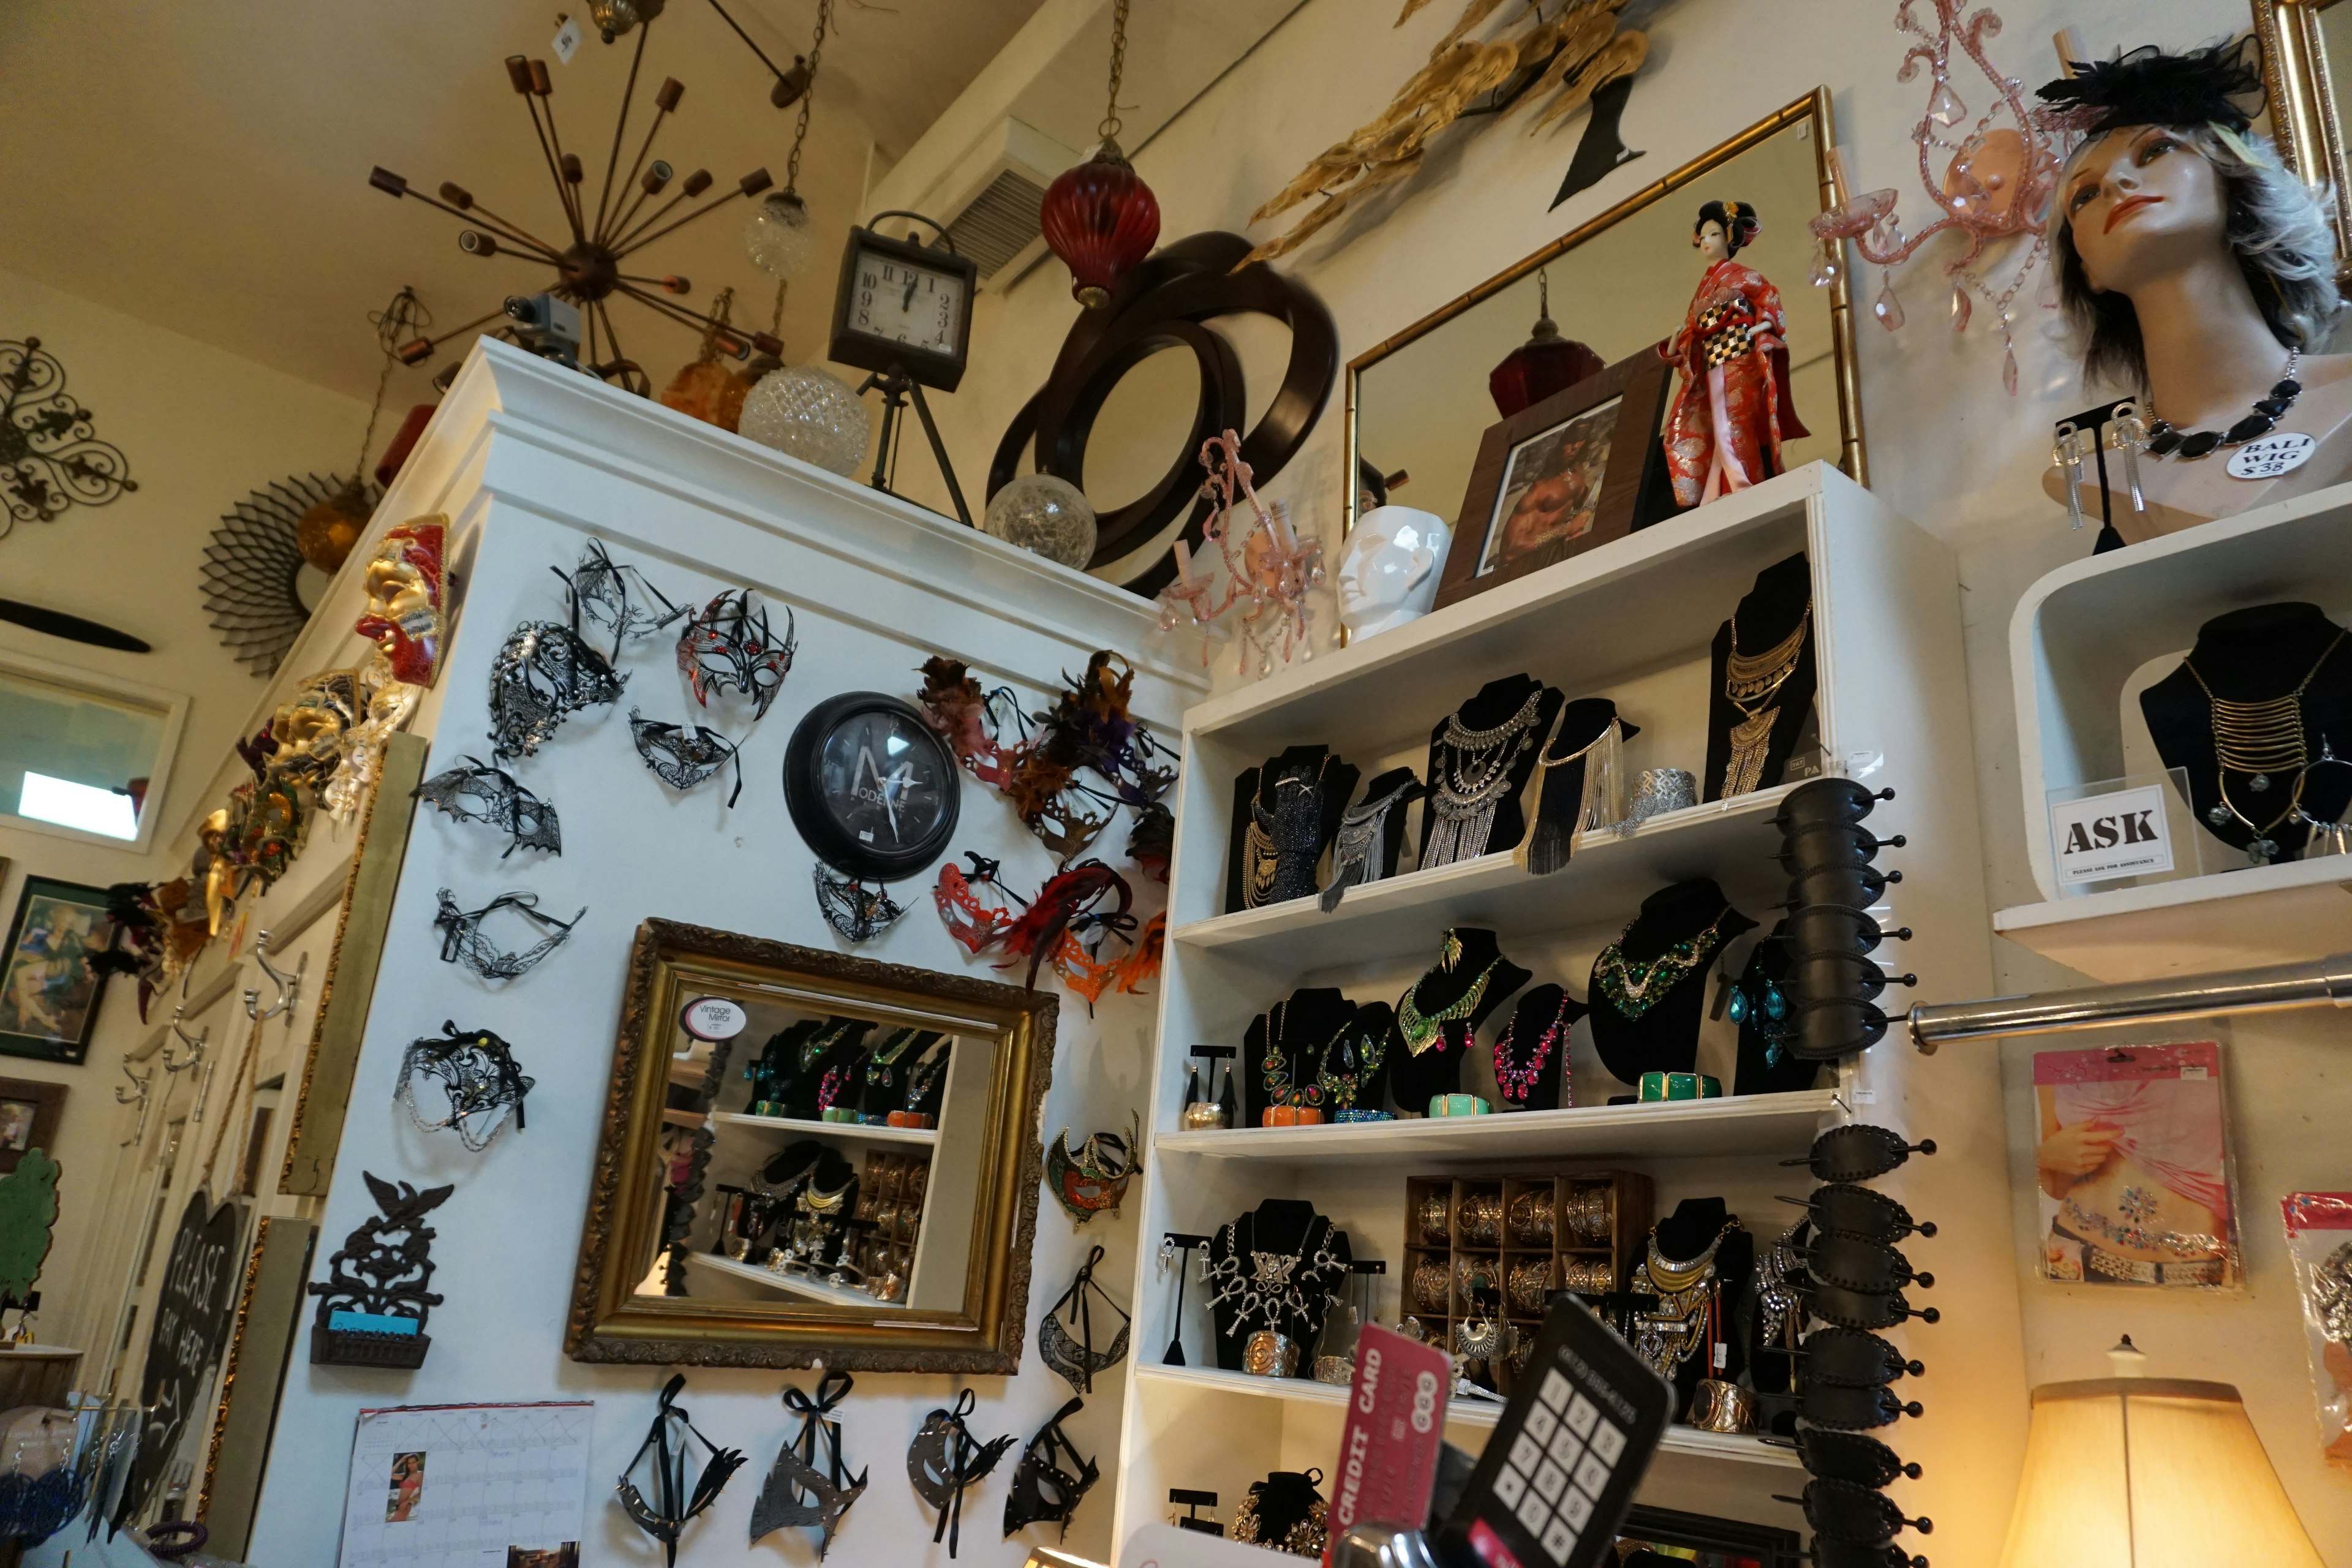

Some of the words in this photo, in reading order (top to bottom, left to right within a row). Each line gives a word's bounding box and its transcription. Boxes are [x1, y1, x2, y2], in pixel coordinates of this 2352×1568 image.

[862, 271, 877, 290] 10
[927, 277, 935, 293] 1
[861, 291, 872, 307] 9
[940, 293, 949, 310] 2
[858, 308, 870, 326] 8
[937, 311, 948, 328] 3
[935, 330, 945, 345] 4
[2244, 438, 2311, 453] BALI
[2243, 451, 2299, 463] WIG
[889, 720, 899, 731] 12
[2064, 809, 2158, 855] ASK
[2073, 867, 2093, 875] PLEASE
[2120, 858, 2155, 867] ASSISTANCE
[699, 1005, 731, 1015] Vintage
[709, 1013, 731, 1022] Mirror
[168, 1227, 226, 1316] PLEASE
[1338, 1425, 1369, 1526] CREDIT
[1359, 1348, 1382, 1414] CARD
